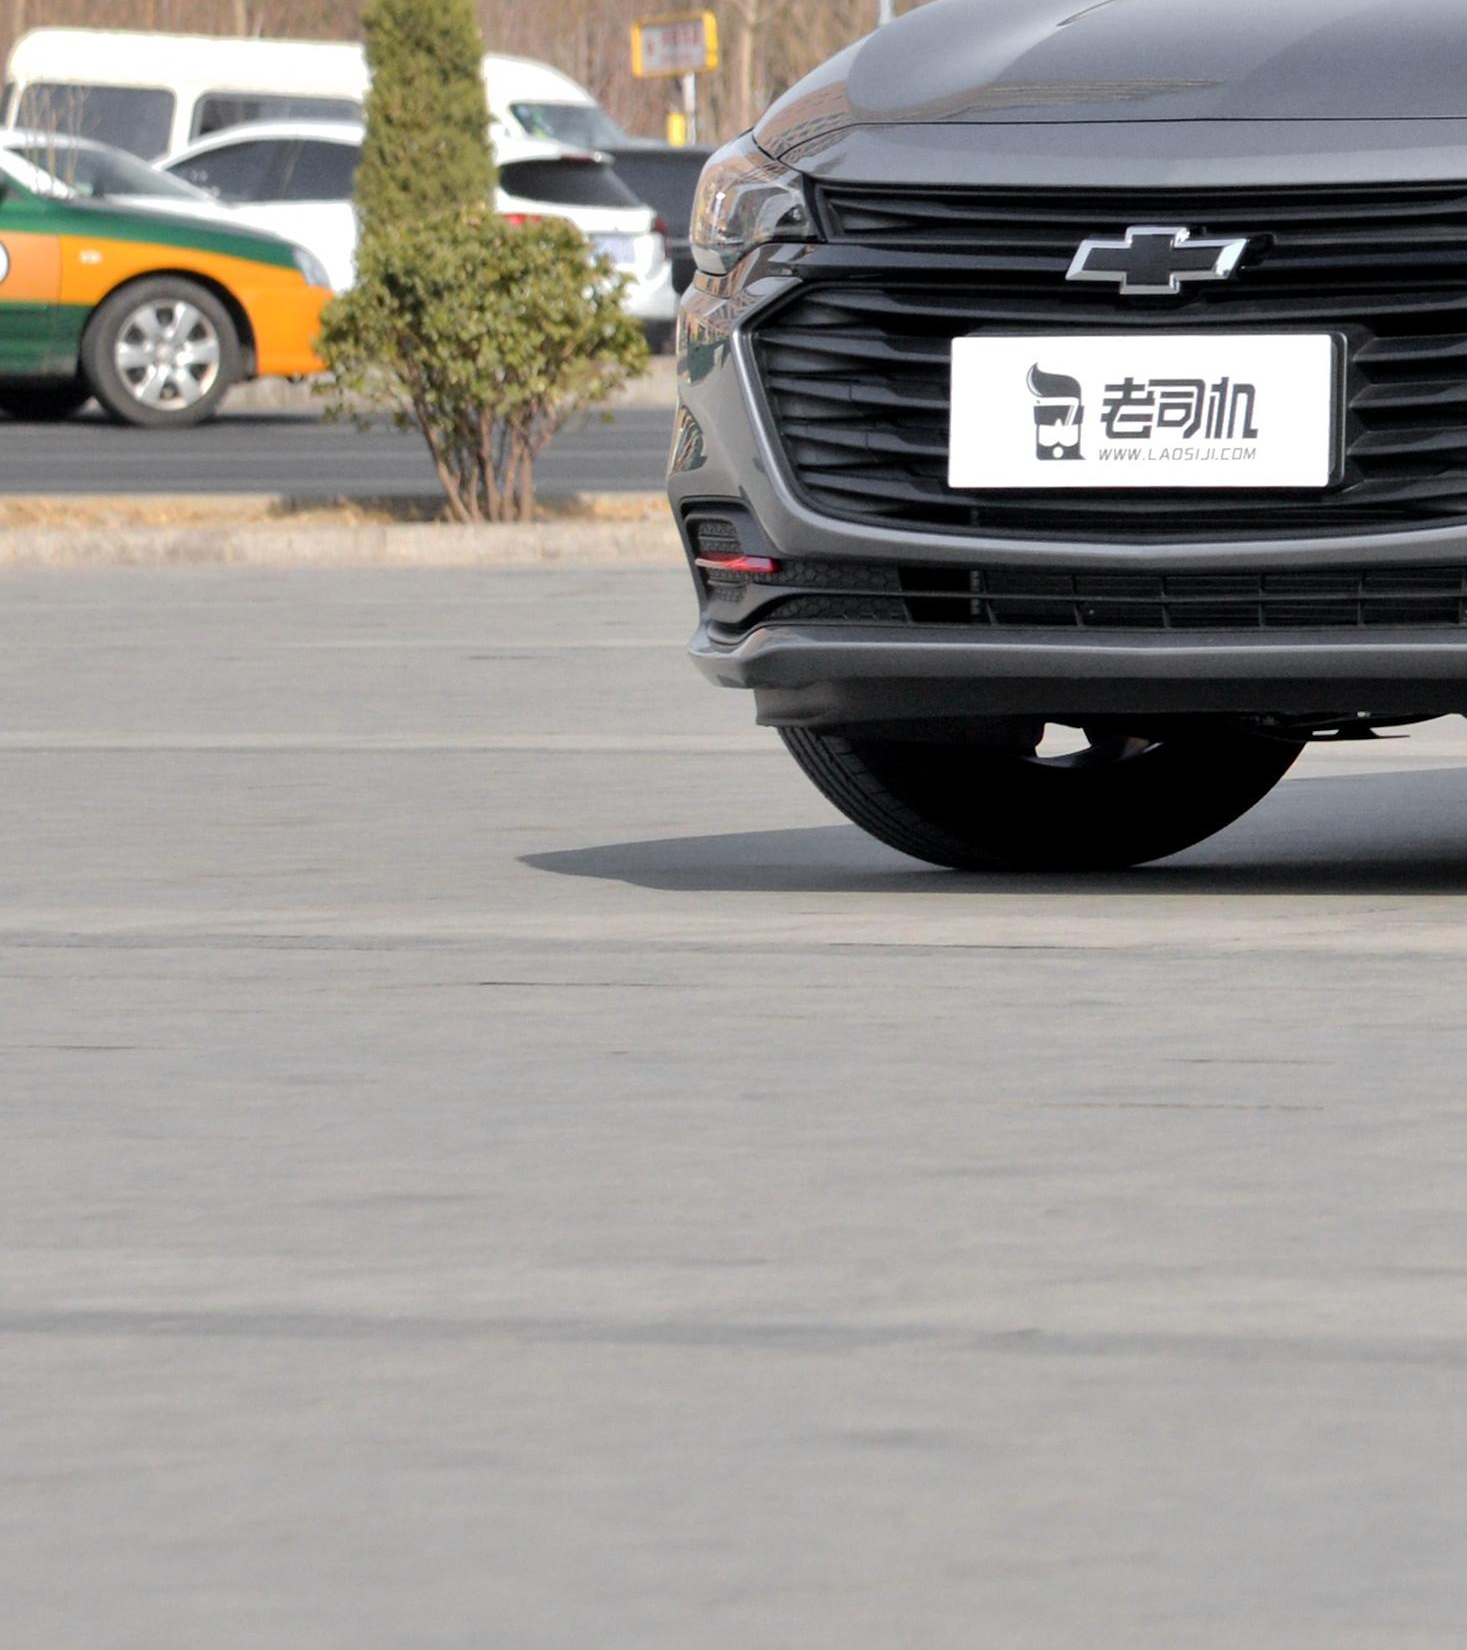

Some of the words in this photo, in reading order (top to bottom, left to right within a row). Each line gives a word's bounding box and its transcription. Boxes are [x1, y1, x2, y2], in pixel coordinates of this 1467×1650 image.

[1100, 377, 1258, 439] 老司机
[1099, 447, 1257, 461] WWW.LAOSIJI.COM
